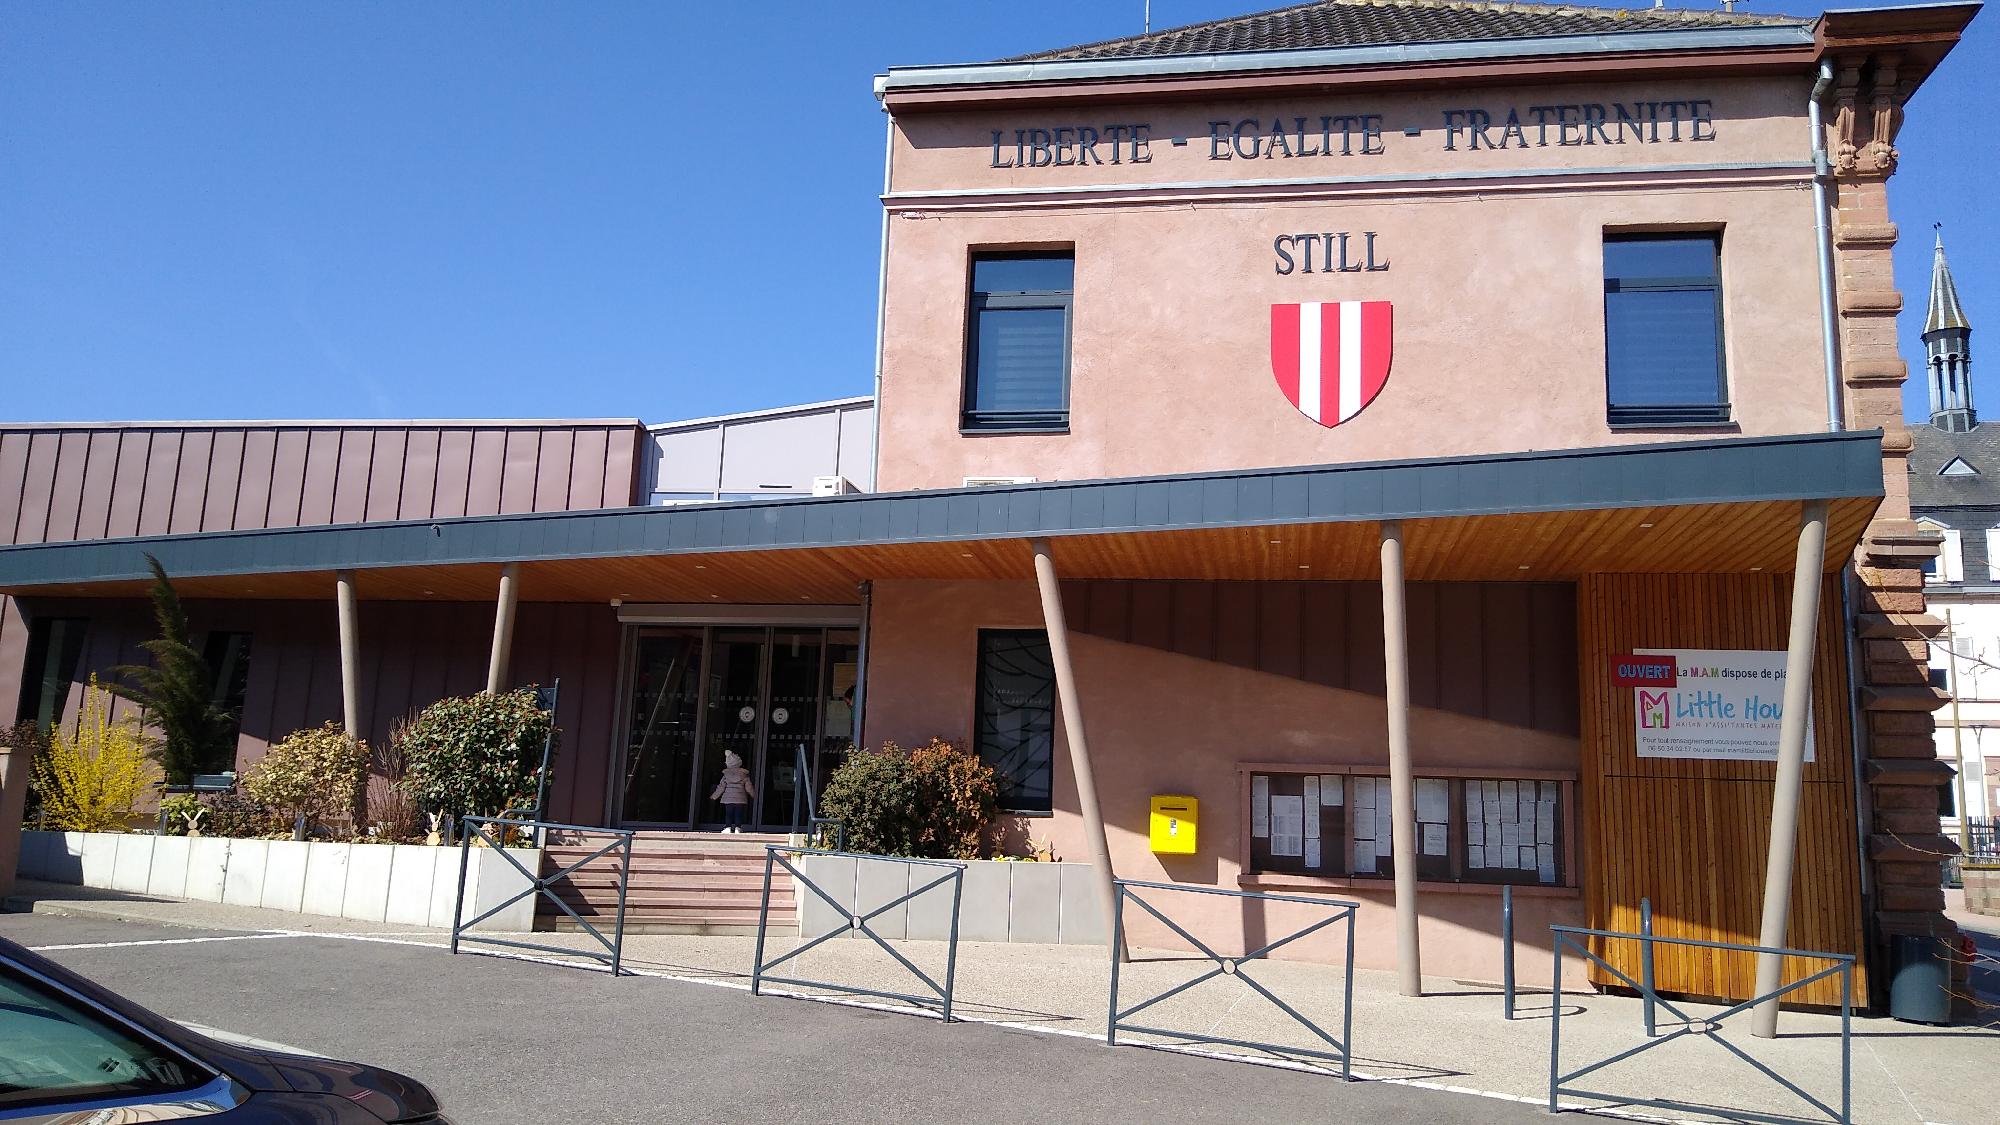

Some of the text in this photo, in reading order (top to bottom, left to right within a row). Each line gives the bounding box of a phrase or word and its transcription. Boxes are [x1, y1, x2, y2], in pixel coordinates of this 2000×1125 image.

[991, 124, 1153, 168] LIBERTE
[1207, 114, 1386, 160] EGALITE
[1442, 100, 1716, 151] FRATERNITE
[1274, 231, 1391, 276] STILL
[1618, 664, 1671, 679] OUVERT
[1676, 667, 1687, 677] La
[1721, 667, 1758, 680] dispose
[1760, 668, 1772, 678] de
[1676, 690, 1736, 719] Little
